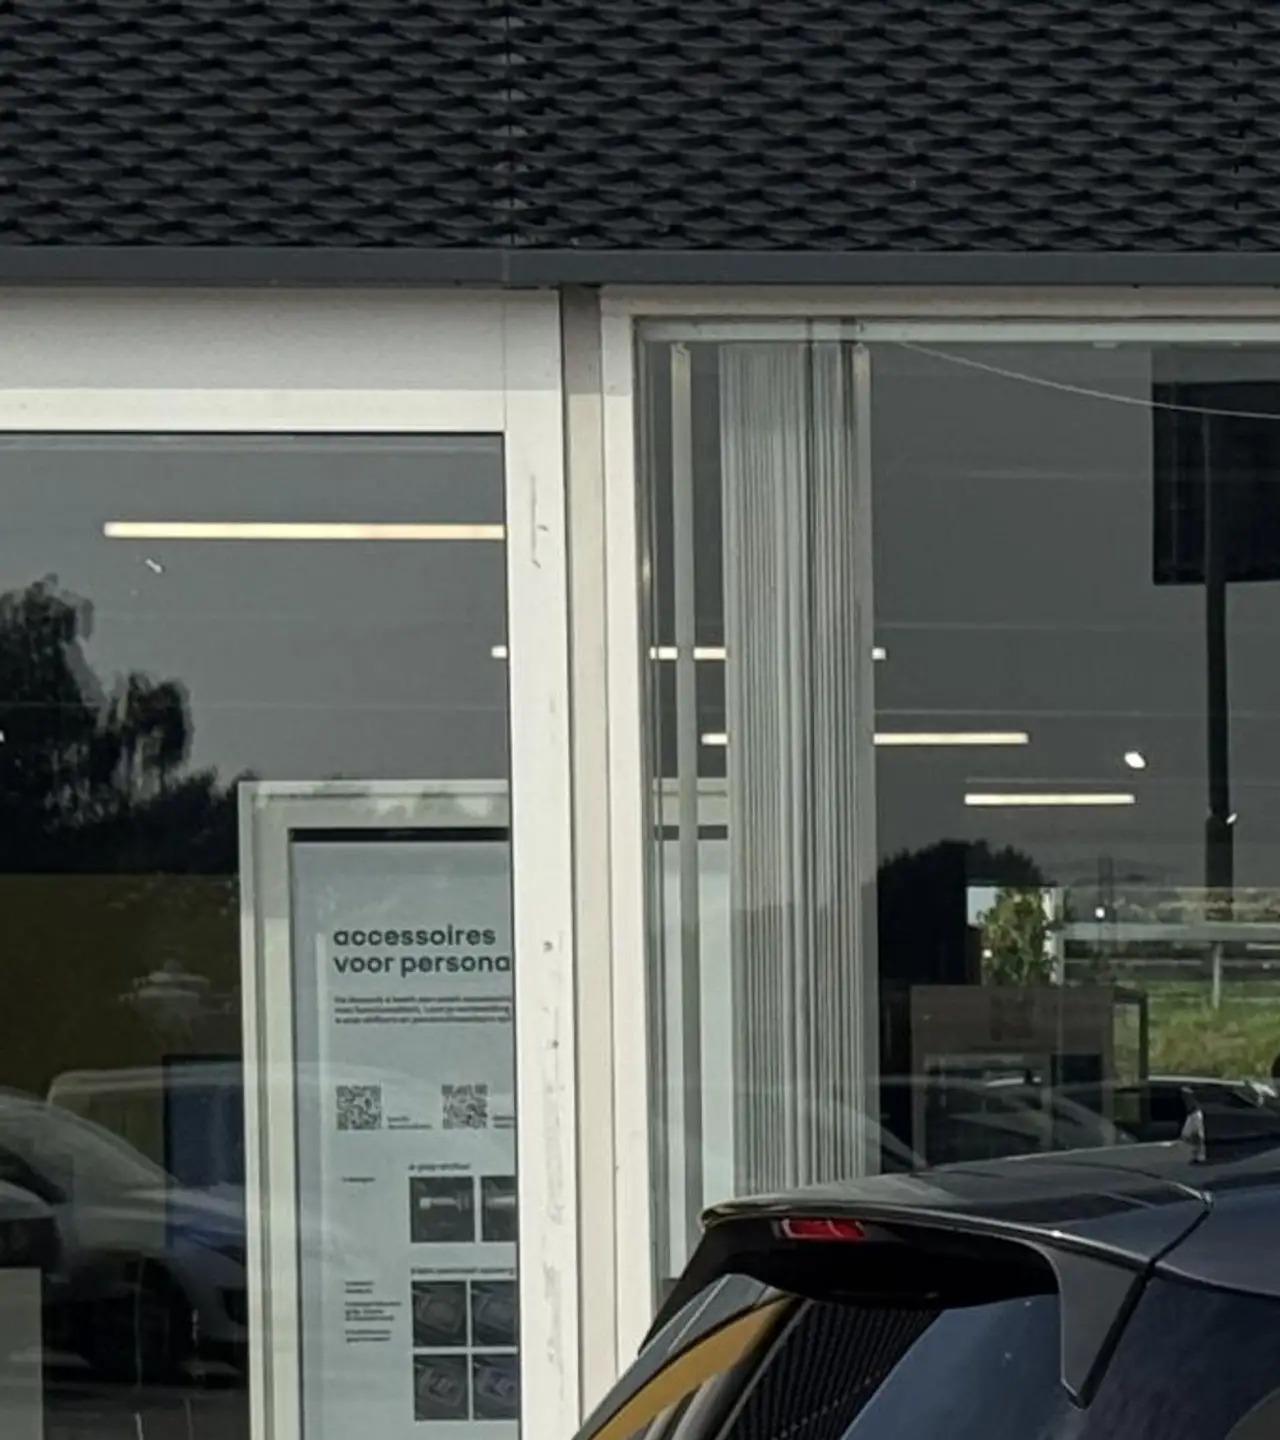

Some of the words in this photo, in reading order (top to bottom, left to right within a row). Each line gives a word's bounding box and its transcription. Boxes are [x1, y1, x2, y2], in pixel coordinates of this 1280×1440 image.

[332, 923, 497, 947] accessoires
[333, 956, 394, 974] voor
[401, 955, 511, 978] persona
